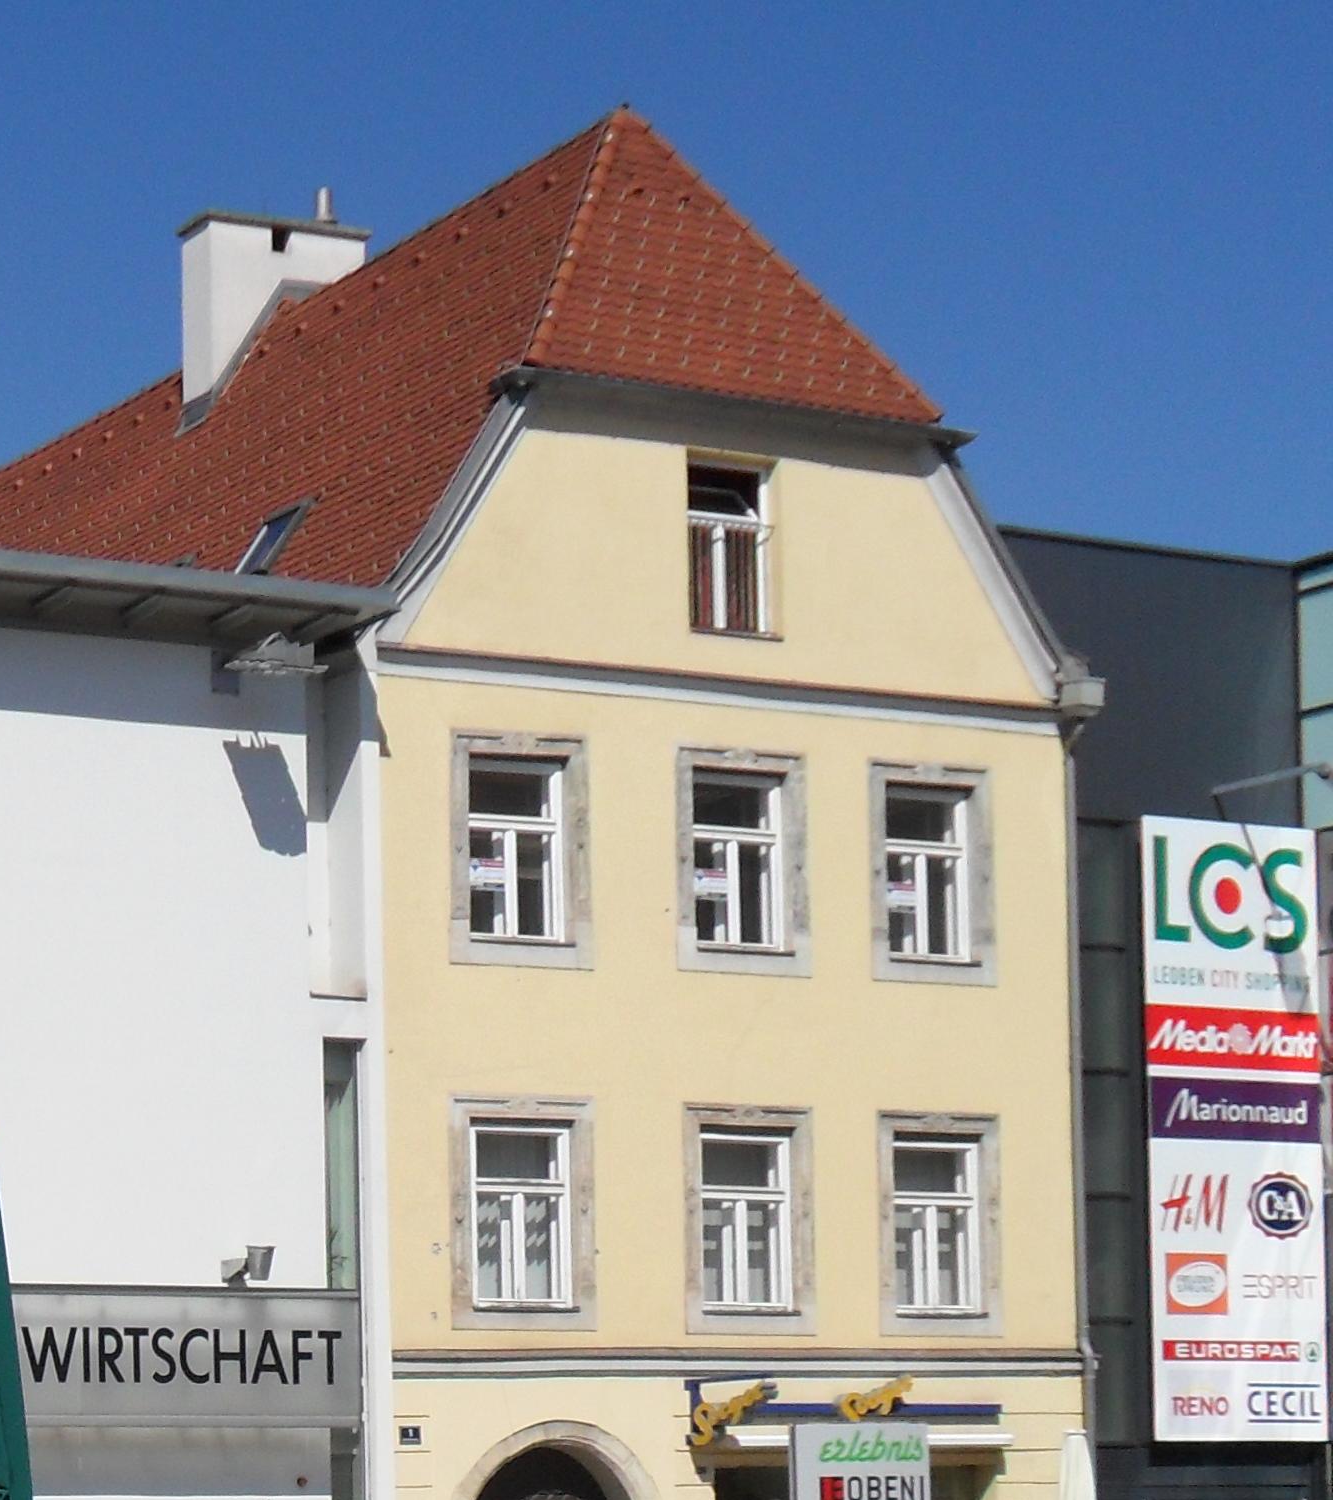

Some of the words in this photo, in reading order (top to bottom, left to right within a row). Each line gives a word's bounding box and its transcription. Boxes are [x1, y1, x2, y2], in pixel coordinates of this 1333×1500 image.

[1153, 835, 1308, 954] LCS
[1153, 965, 1205, 985] LEOBEN
[1211, 970, 1238, 988] CITY
[1245, 972, 1309, 992] SHOPPING
[1164, 1088, 1308, 1128] Marionnaud
[1160, 1173, 1229, 1233] H&M
[1259, 1190, 1304, 1221] C&A
[1243, 1274, 1317, 1299] ESPRIT
[21, 1326, 342, 1385] WIRTSCHAFT
[1174, 1342, 1299, 1359] EUROSPAR
[1171, 1396, 1229, 1416] RENO
[1248, 1391, 1321, 1416] CECIL
[819, 1430, 925, 1462] erlebnis
